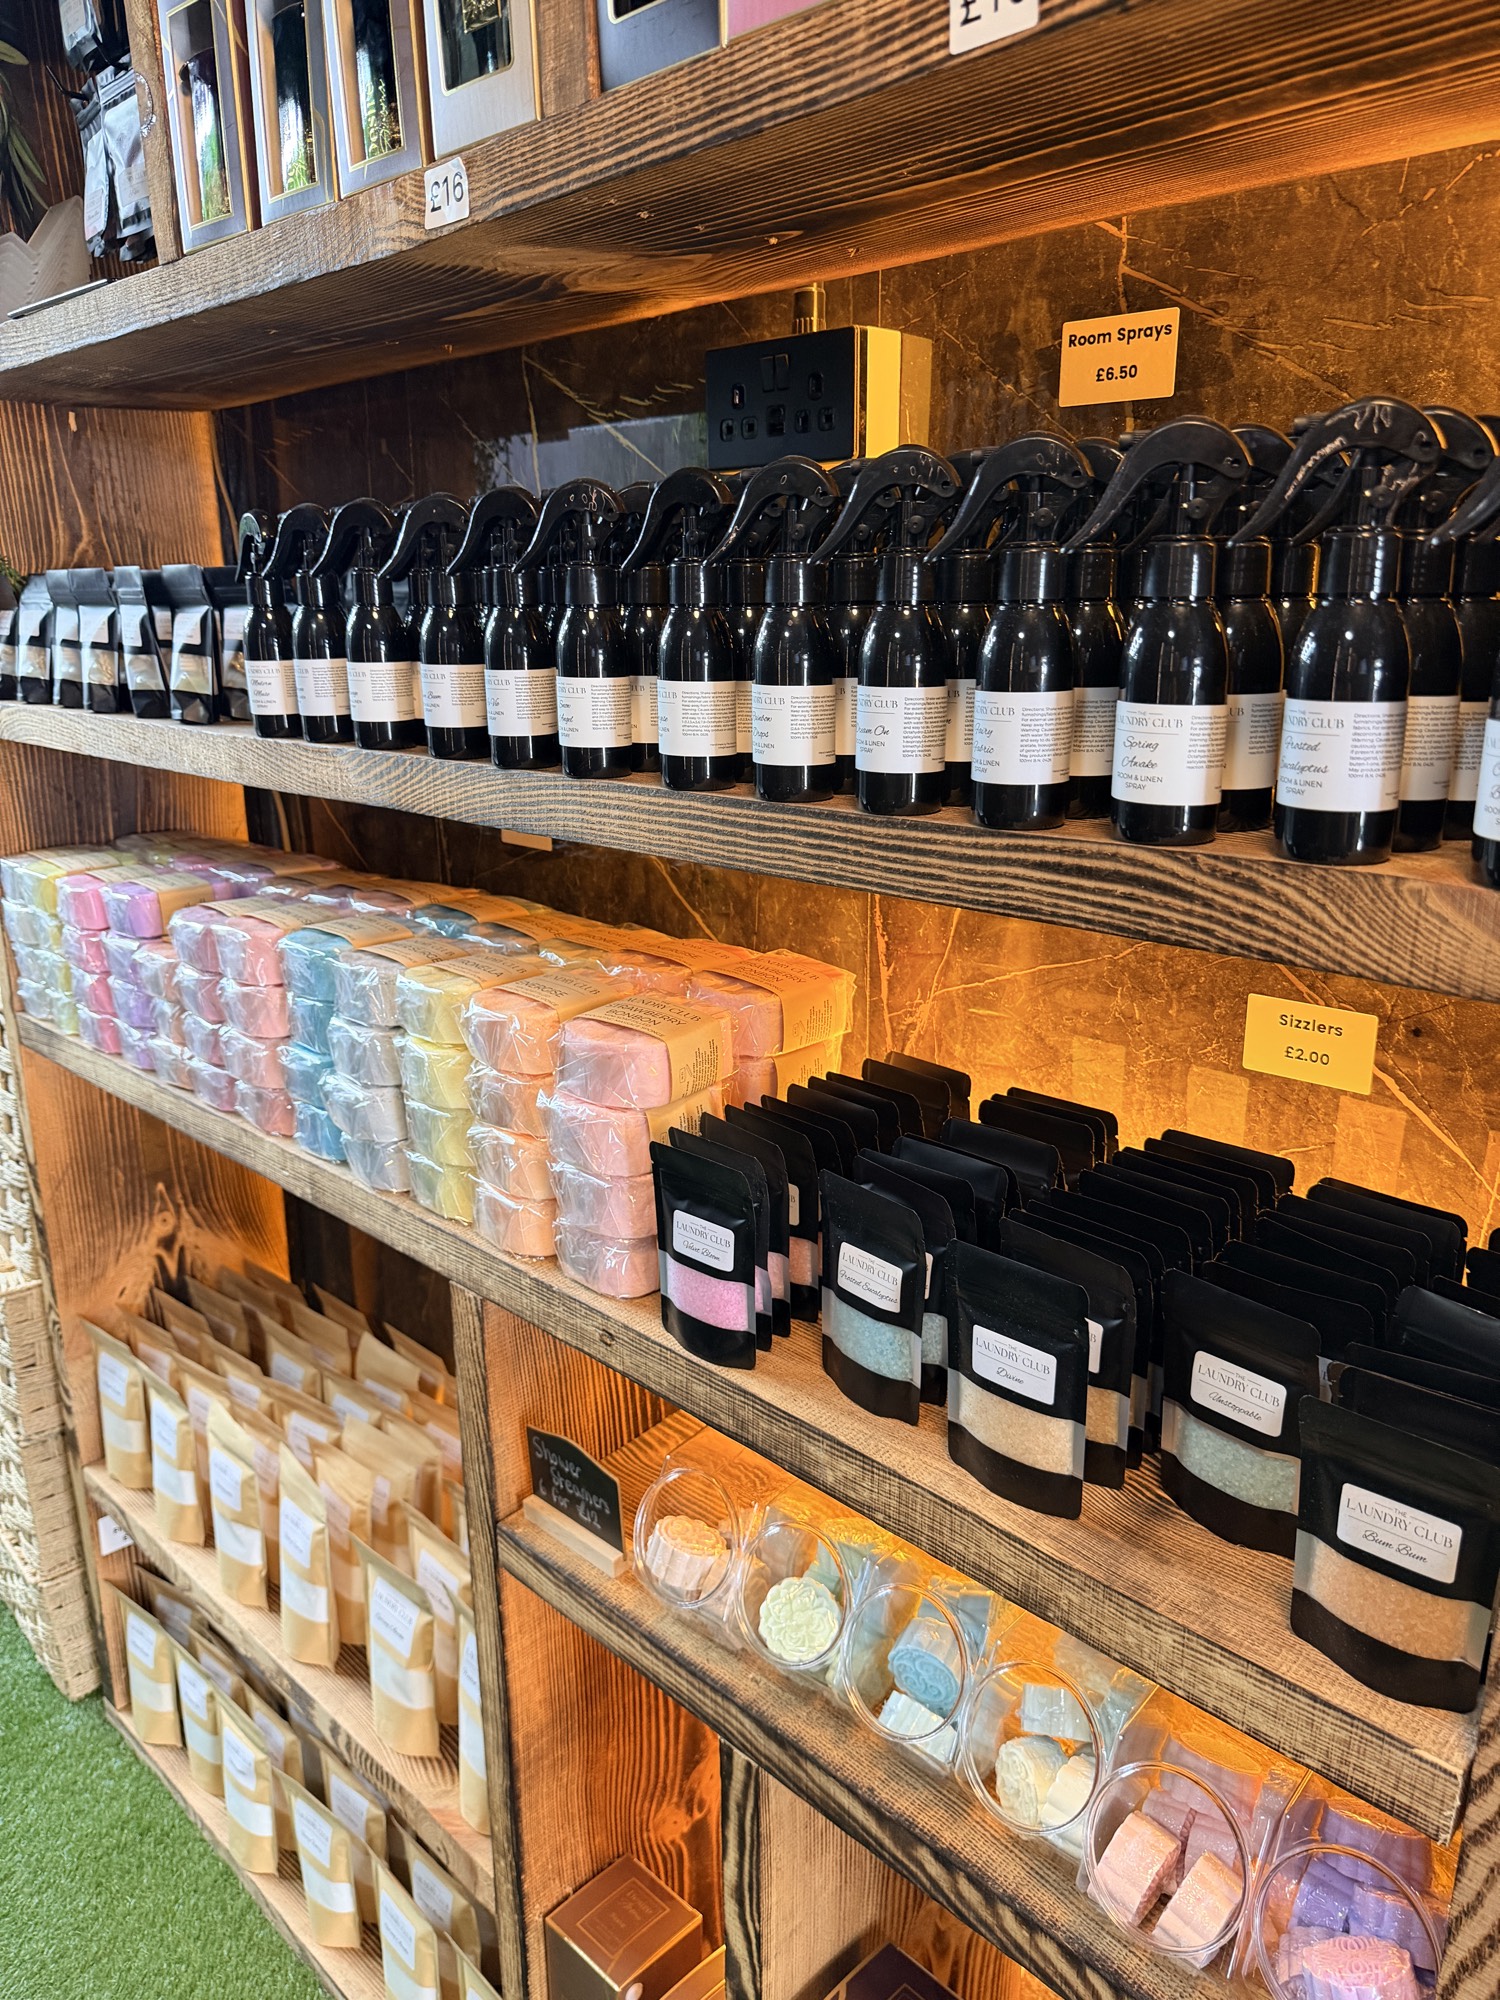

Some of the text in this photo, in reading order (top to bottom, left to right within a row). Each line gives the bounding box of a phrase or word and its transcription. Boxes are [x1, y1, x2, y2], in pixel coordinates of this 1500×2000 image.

[430, 171, 464, 213] £16
[1068, 324, 1173, 348] Room Sprays
[1096, 364, 1138, 382] £6.50
[661, 691, 677, 699] CLUB
[764, 696, 785, 705] CLUB
[874, 700, 898, 709] CLUB
[989, 706, 1015, 716] CLUB
[874, 724, 890, 736] On
[1152, 718, 1183, 728] CLUB
[1311, 718, 1345, 729] CLUB
[1123, 735, 1159, 752] Spring
[1284, 735, 1321, 752] Frosted
[1121, 755, 1157, 769] Awake
[1125, 781, 1146, 790] SPRAY
[1285, 786, 1306, 796] SPRAY
[1300, 779, 1323, 788] LINEN
[574, 982, 600, 995] CLUB
[605, 1009, 662, 1026] BONBON
[606, 1003, 687, 1026] STRAWBERRY
[669, 1008, 702, 1022] CLUB
[1279, 1014, 1343, 1036] Sizzlers
[1284, 1046, 1330, 1065] £2.00
[676, 1220, 731, 1248] LAUNDRY CLUB
[682, 1239, 720, 1261] Velvet Bloom
[842, 1251, 898, 1286] LAUNDRY CLUB
[839, 1269, 899, 1304] Frosted Eucalyptus
[975, 1337, 1051, 1375] LAUNDRY CLUB
[996, 1366, 1025, 1385] Divine
[1235, 1372, 1246, 1381] THE
[1198, 1364, 1280, 1408] LAUNDRY CLUB
[1208, 1391, 1262, 1422] Unstoppable
[532, 1436, 581, 1478] Shower
[551, 1466, 610, 1514] Steamers
[1394, 1508, 1408, 1518] THE
[1346, 1498, 1453, 1549] LAUNDRY CLUB
[1362, 1529, 1428, 1563] Bum Bum
